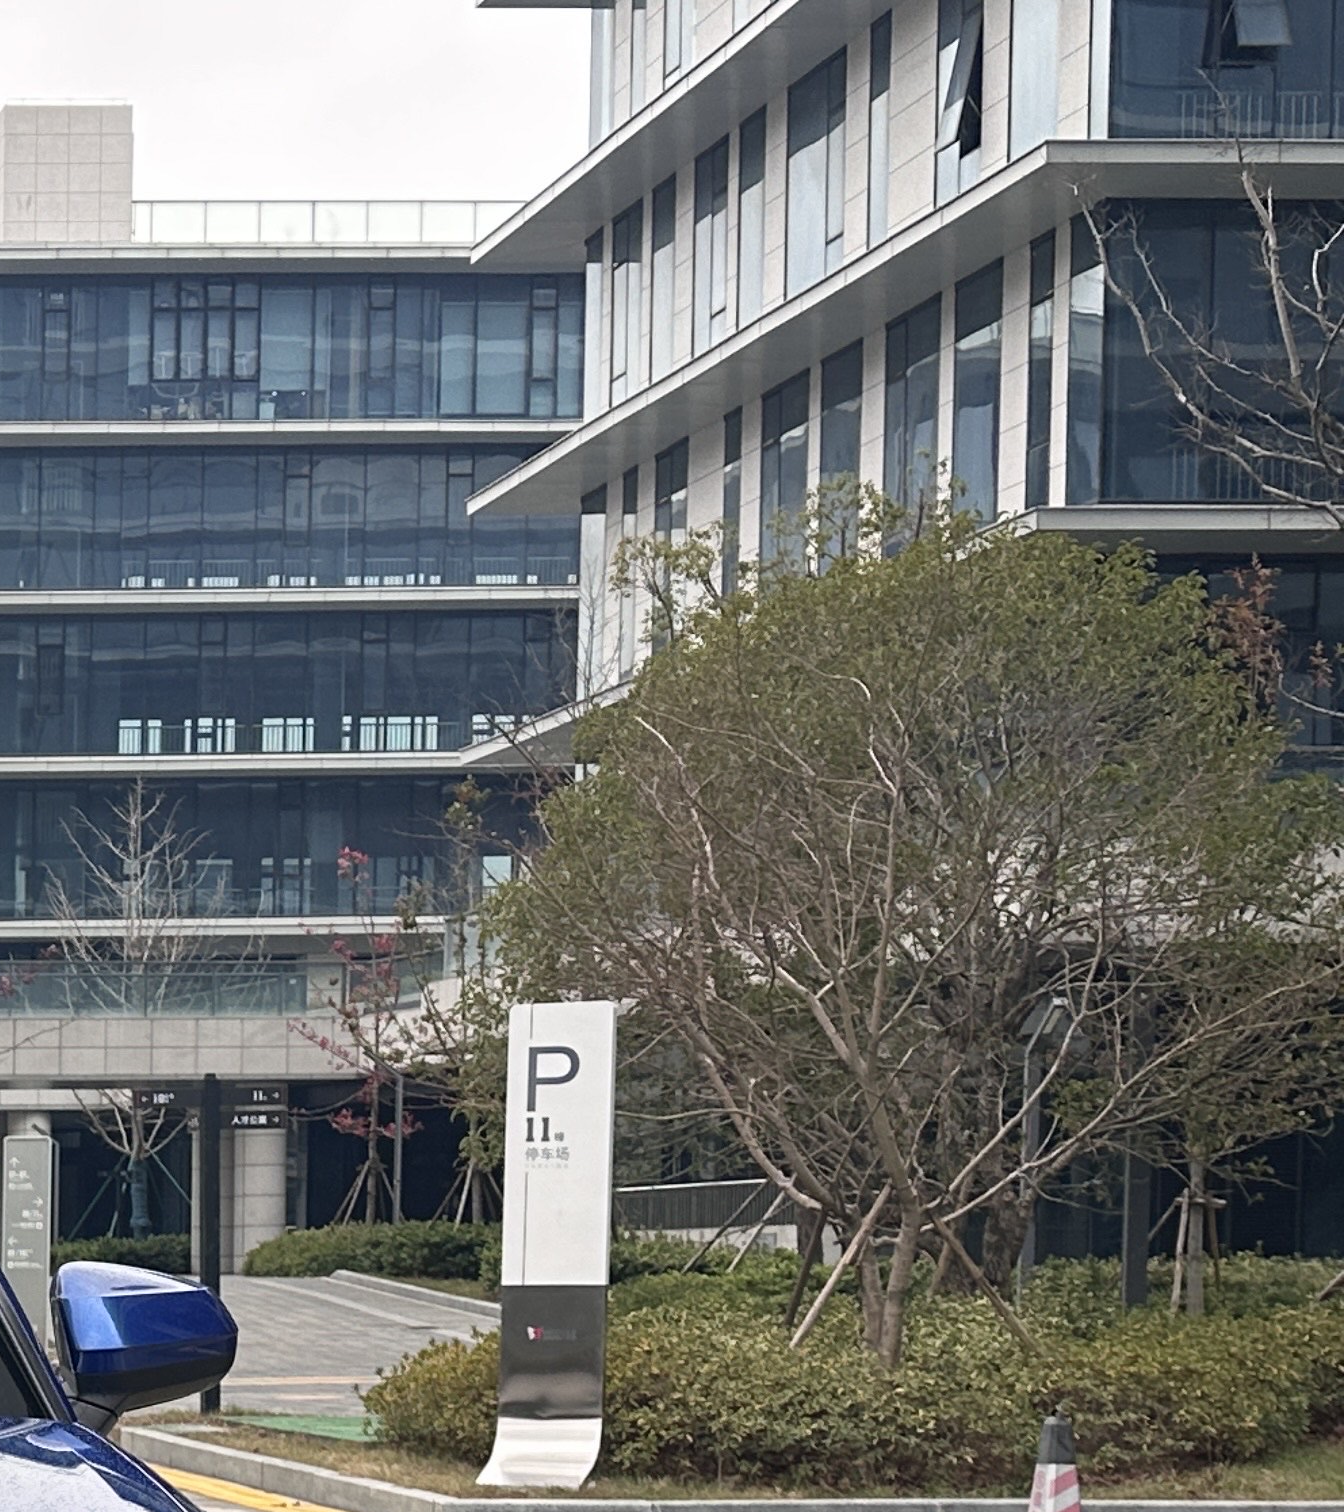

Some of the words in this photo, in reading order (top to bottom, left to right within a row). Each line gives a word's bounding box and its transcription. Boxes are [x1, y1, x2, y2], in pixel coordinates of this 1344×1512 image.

[526, 1045, 580, 1112] P
[525, 1146, 570, 1161] 停车场
